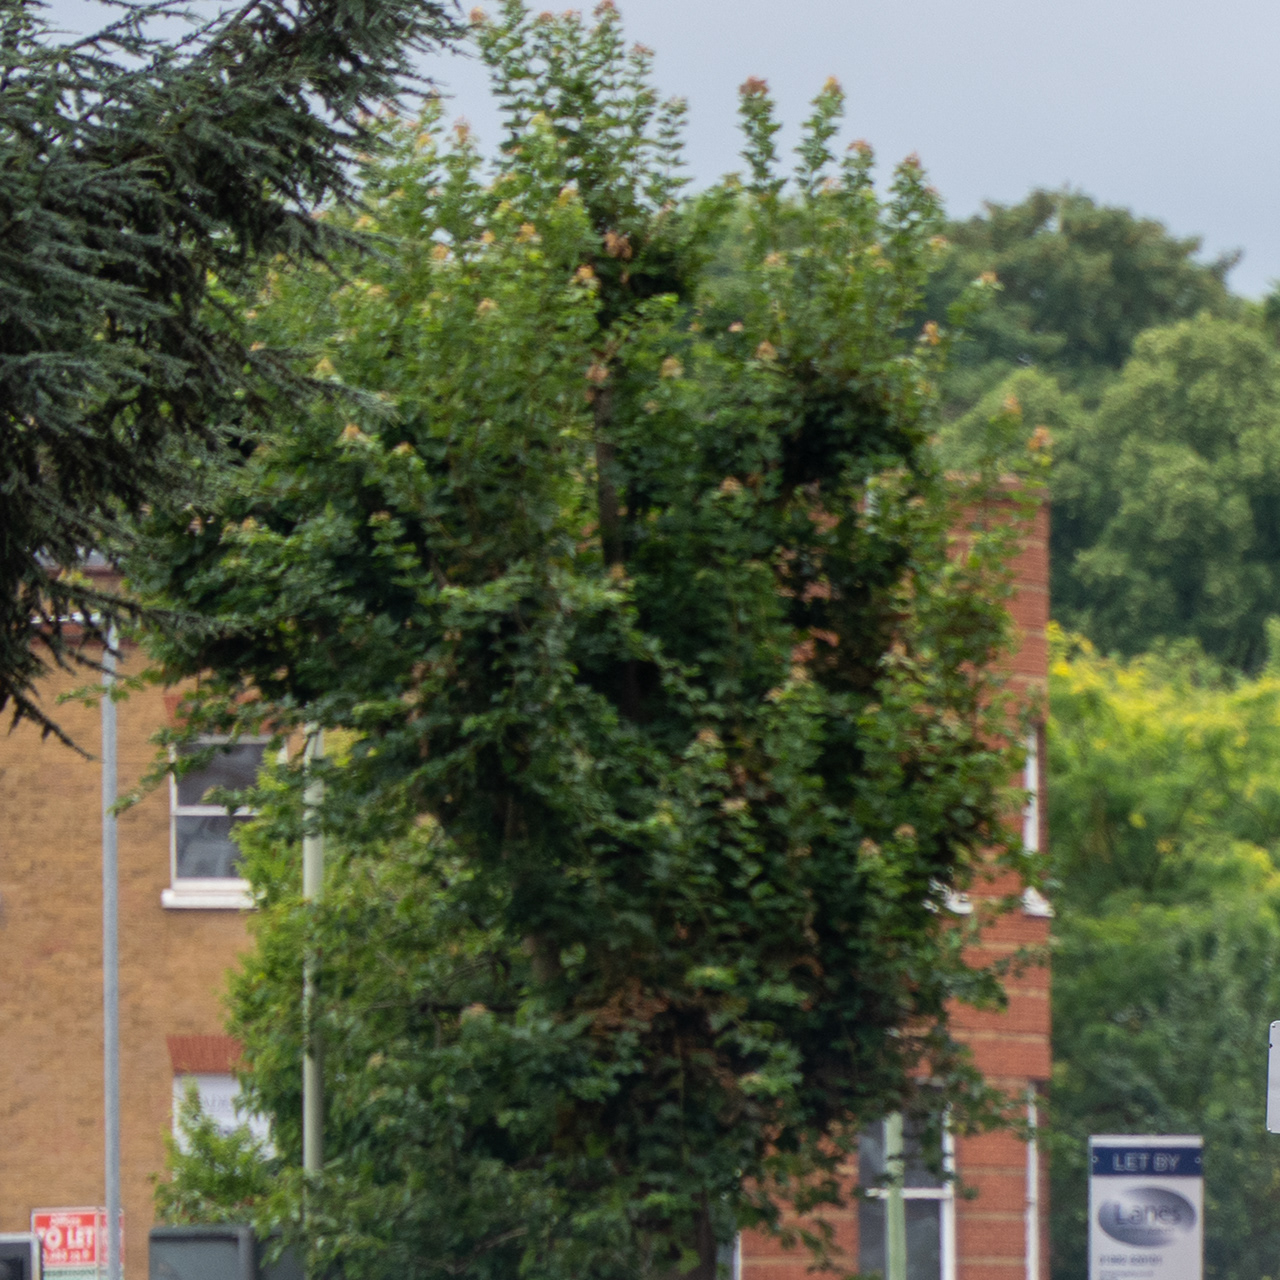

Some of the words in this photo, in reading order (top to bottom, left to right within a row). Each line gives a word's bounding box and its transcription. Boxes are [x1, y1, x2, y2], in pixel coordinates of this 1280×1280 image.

[1113, 1153, 1149, 1172] LET
[1153, 1153, 1180, 1172] BY
[66, 1226, 95, 1250] LET
